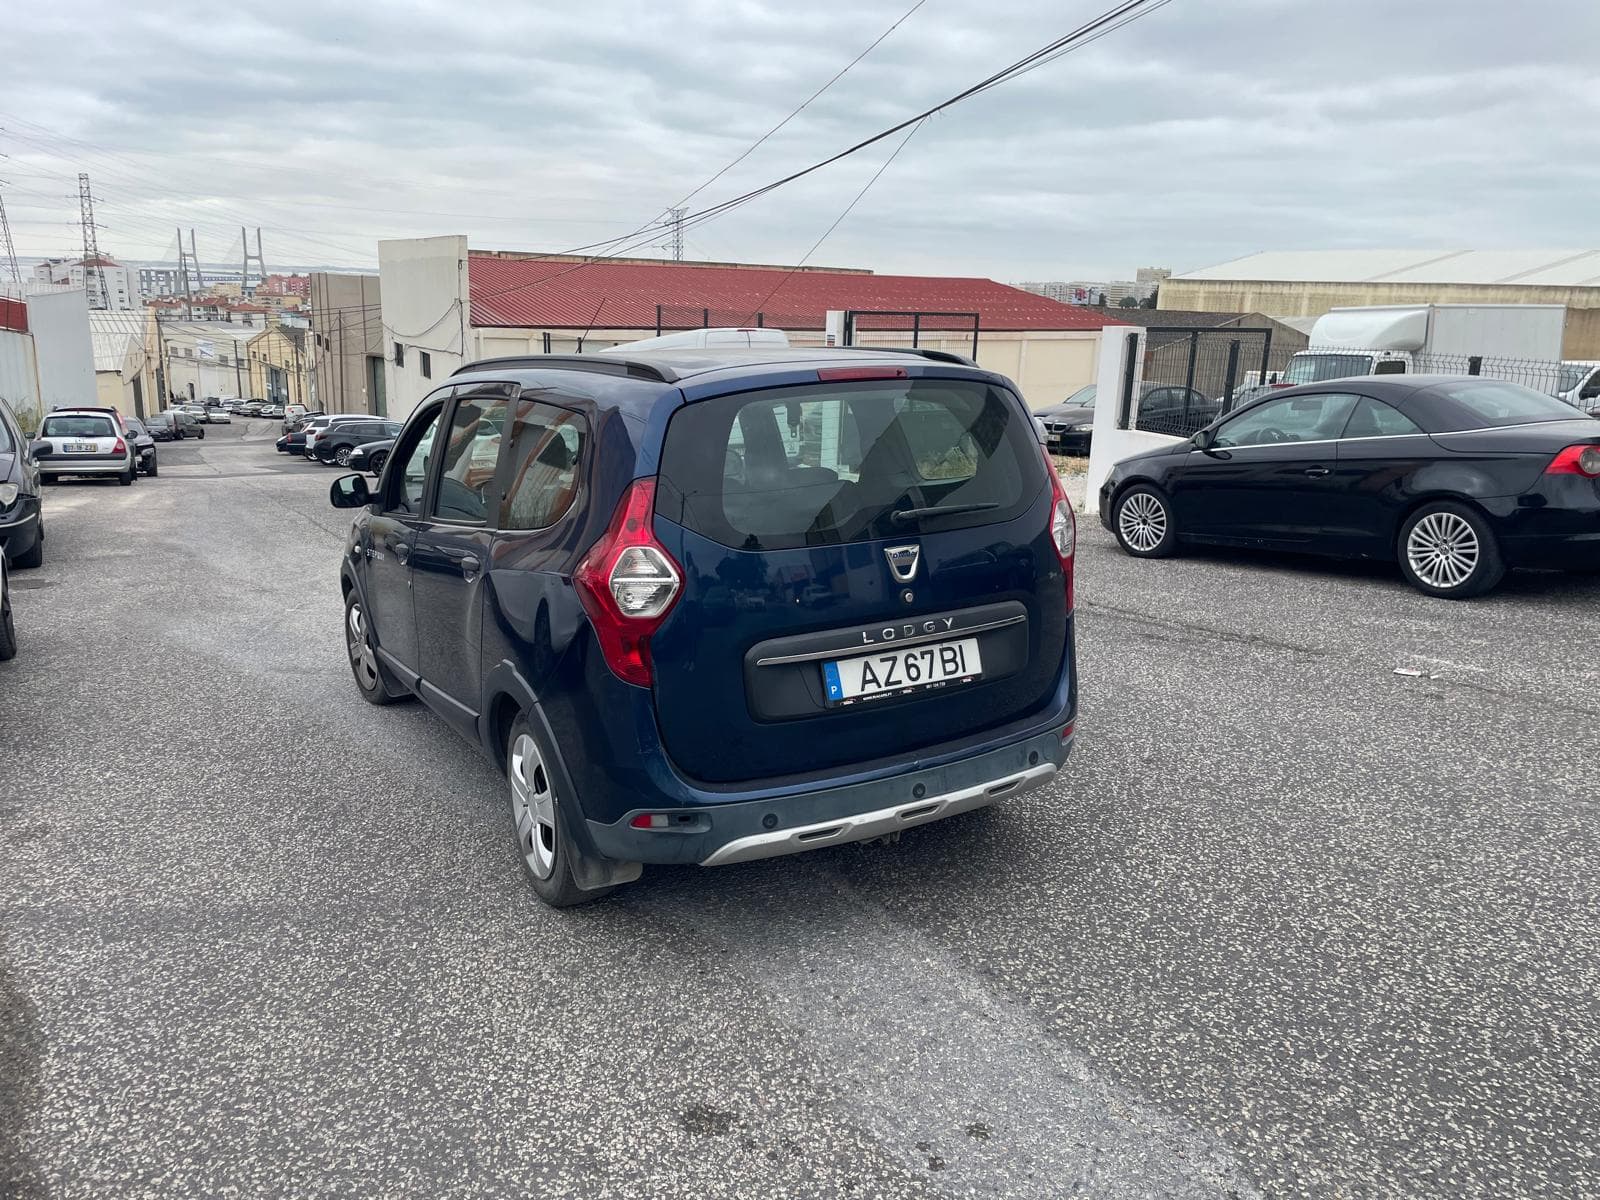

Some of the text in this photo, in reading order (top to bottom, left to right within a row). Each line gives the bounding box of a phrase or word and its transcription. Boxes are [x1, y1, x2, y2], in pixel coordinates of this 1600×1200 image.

[862, 617, 953, 644] LODGY
[860, 644, 966, 692] AZ67BI
[831, 685, 838, 695] P
